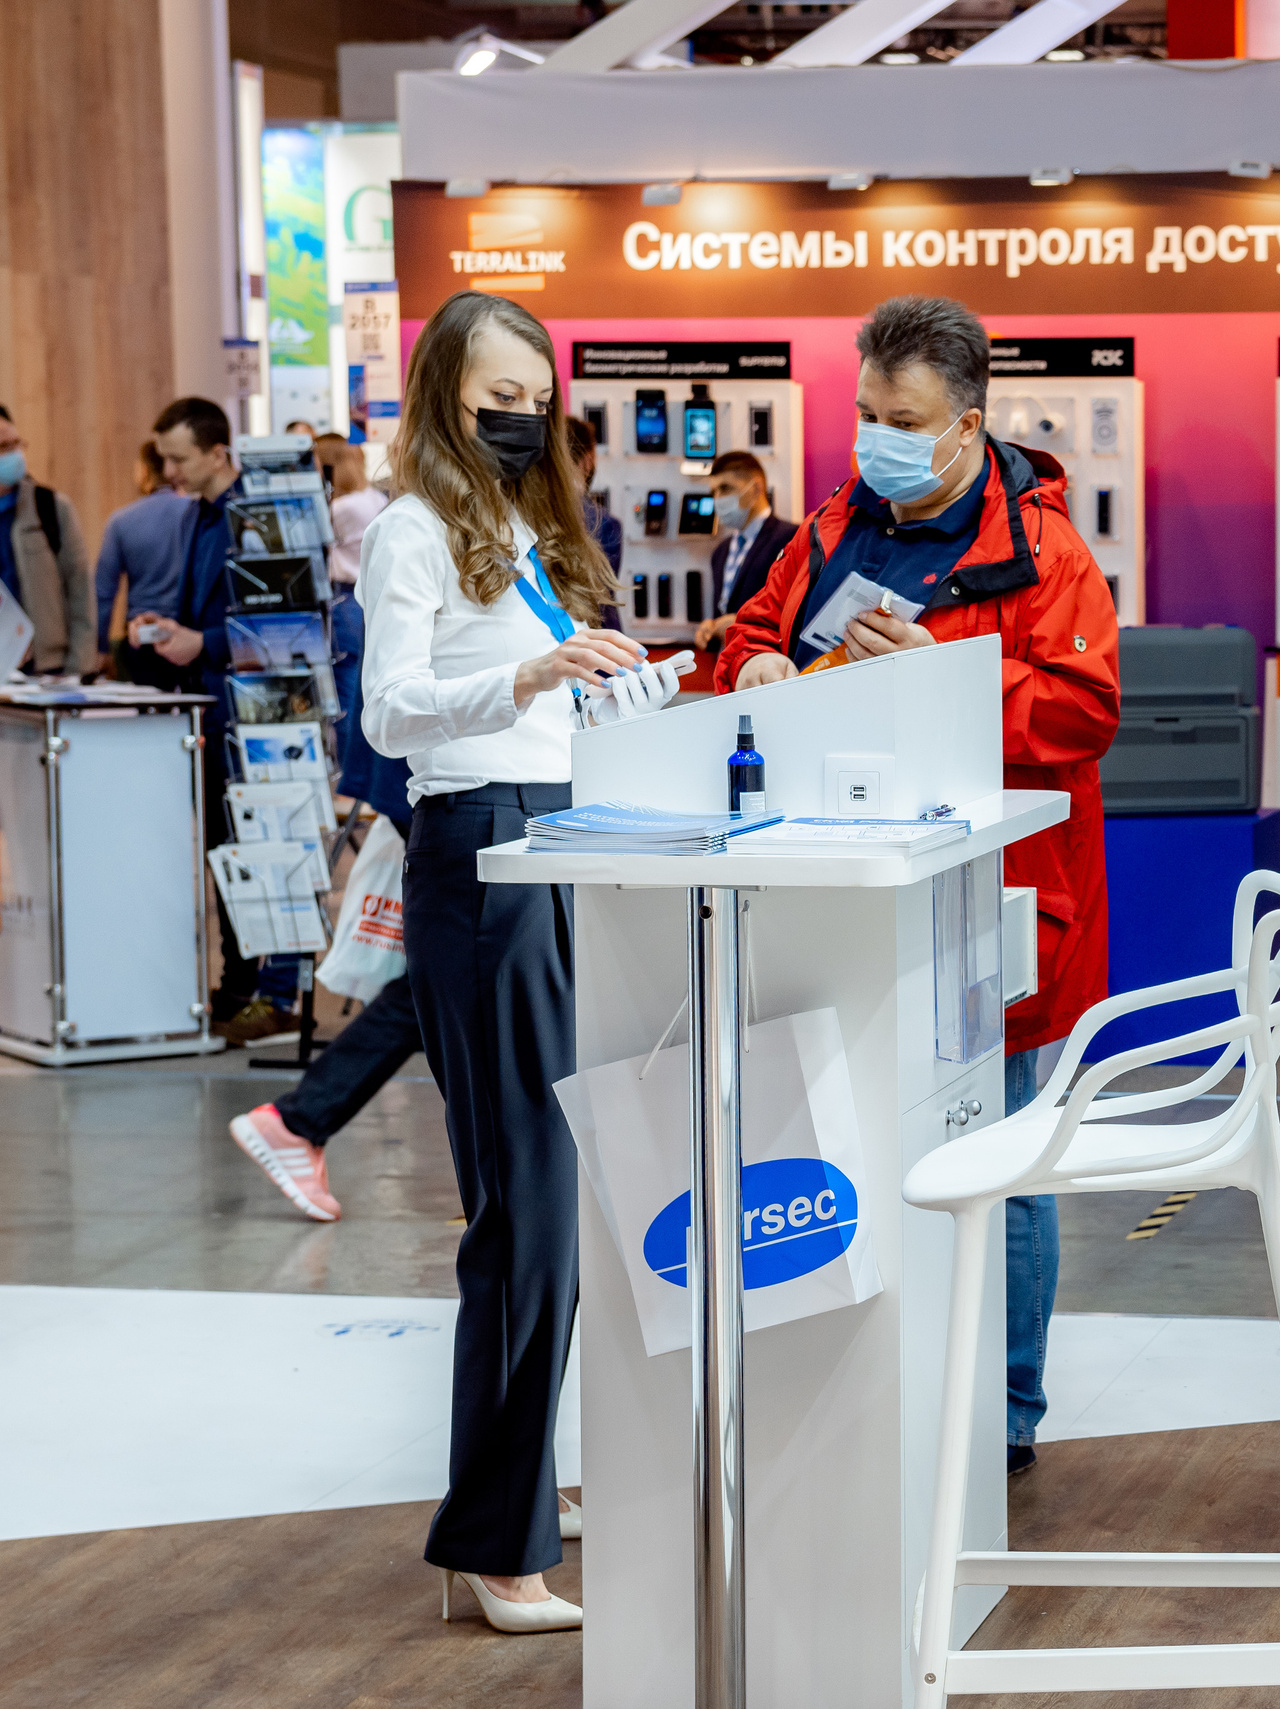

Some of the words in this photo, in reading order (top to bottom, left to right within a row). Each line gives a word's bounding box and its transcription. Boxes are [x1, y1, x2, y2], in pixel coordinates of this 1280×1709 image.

[449, 250, 566, 273] TERRALINK
[623, 221, 868, 270] Системы
[882, 227, 1134, 278] контроля
